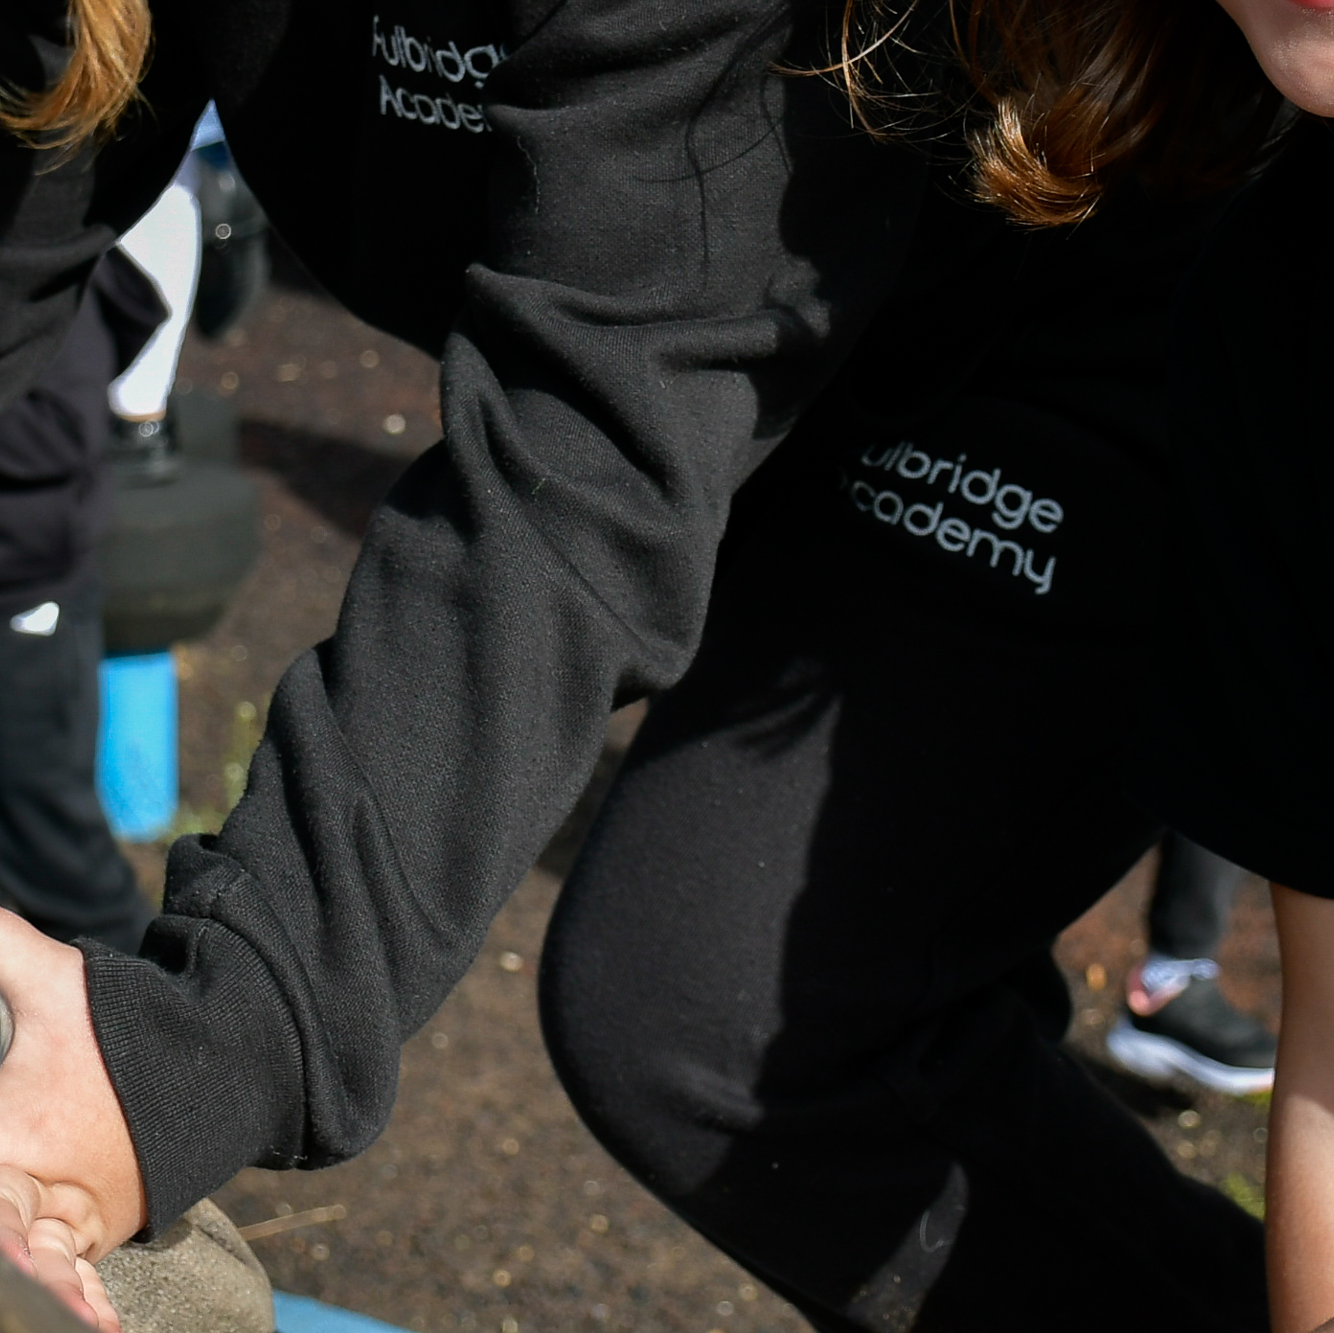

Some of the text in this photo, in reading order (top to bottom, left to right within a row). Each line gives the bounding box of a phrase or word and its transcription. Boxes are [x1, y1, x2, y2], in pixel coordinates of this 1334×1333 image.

[378, 73, 493, 134] Acade
[838, 469, 1057, 595] cademy
[860, 440, 1065, 534] ulbridge
